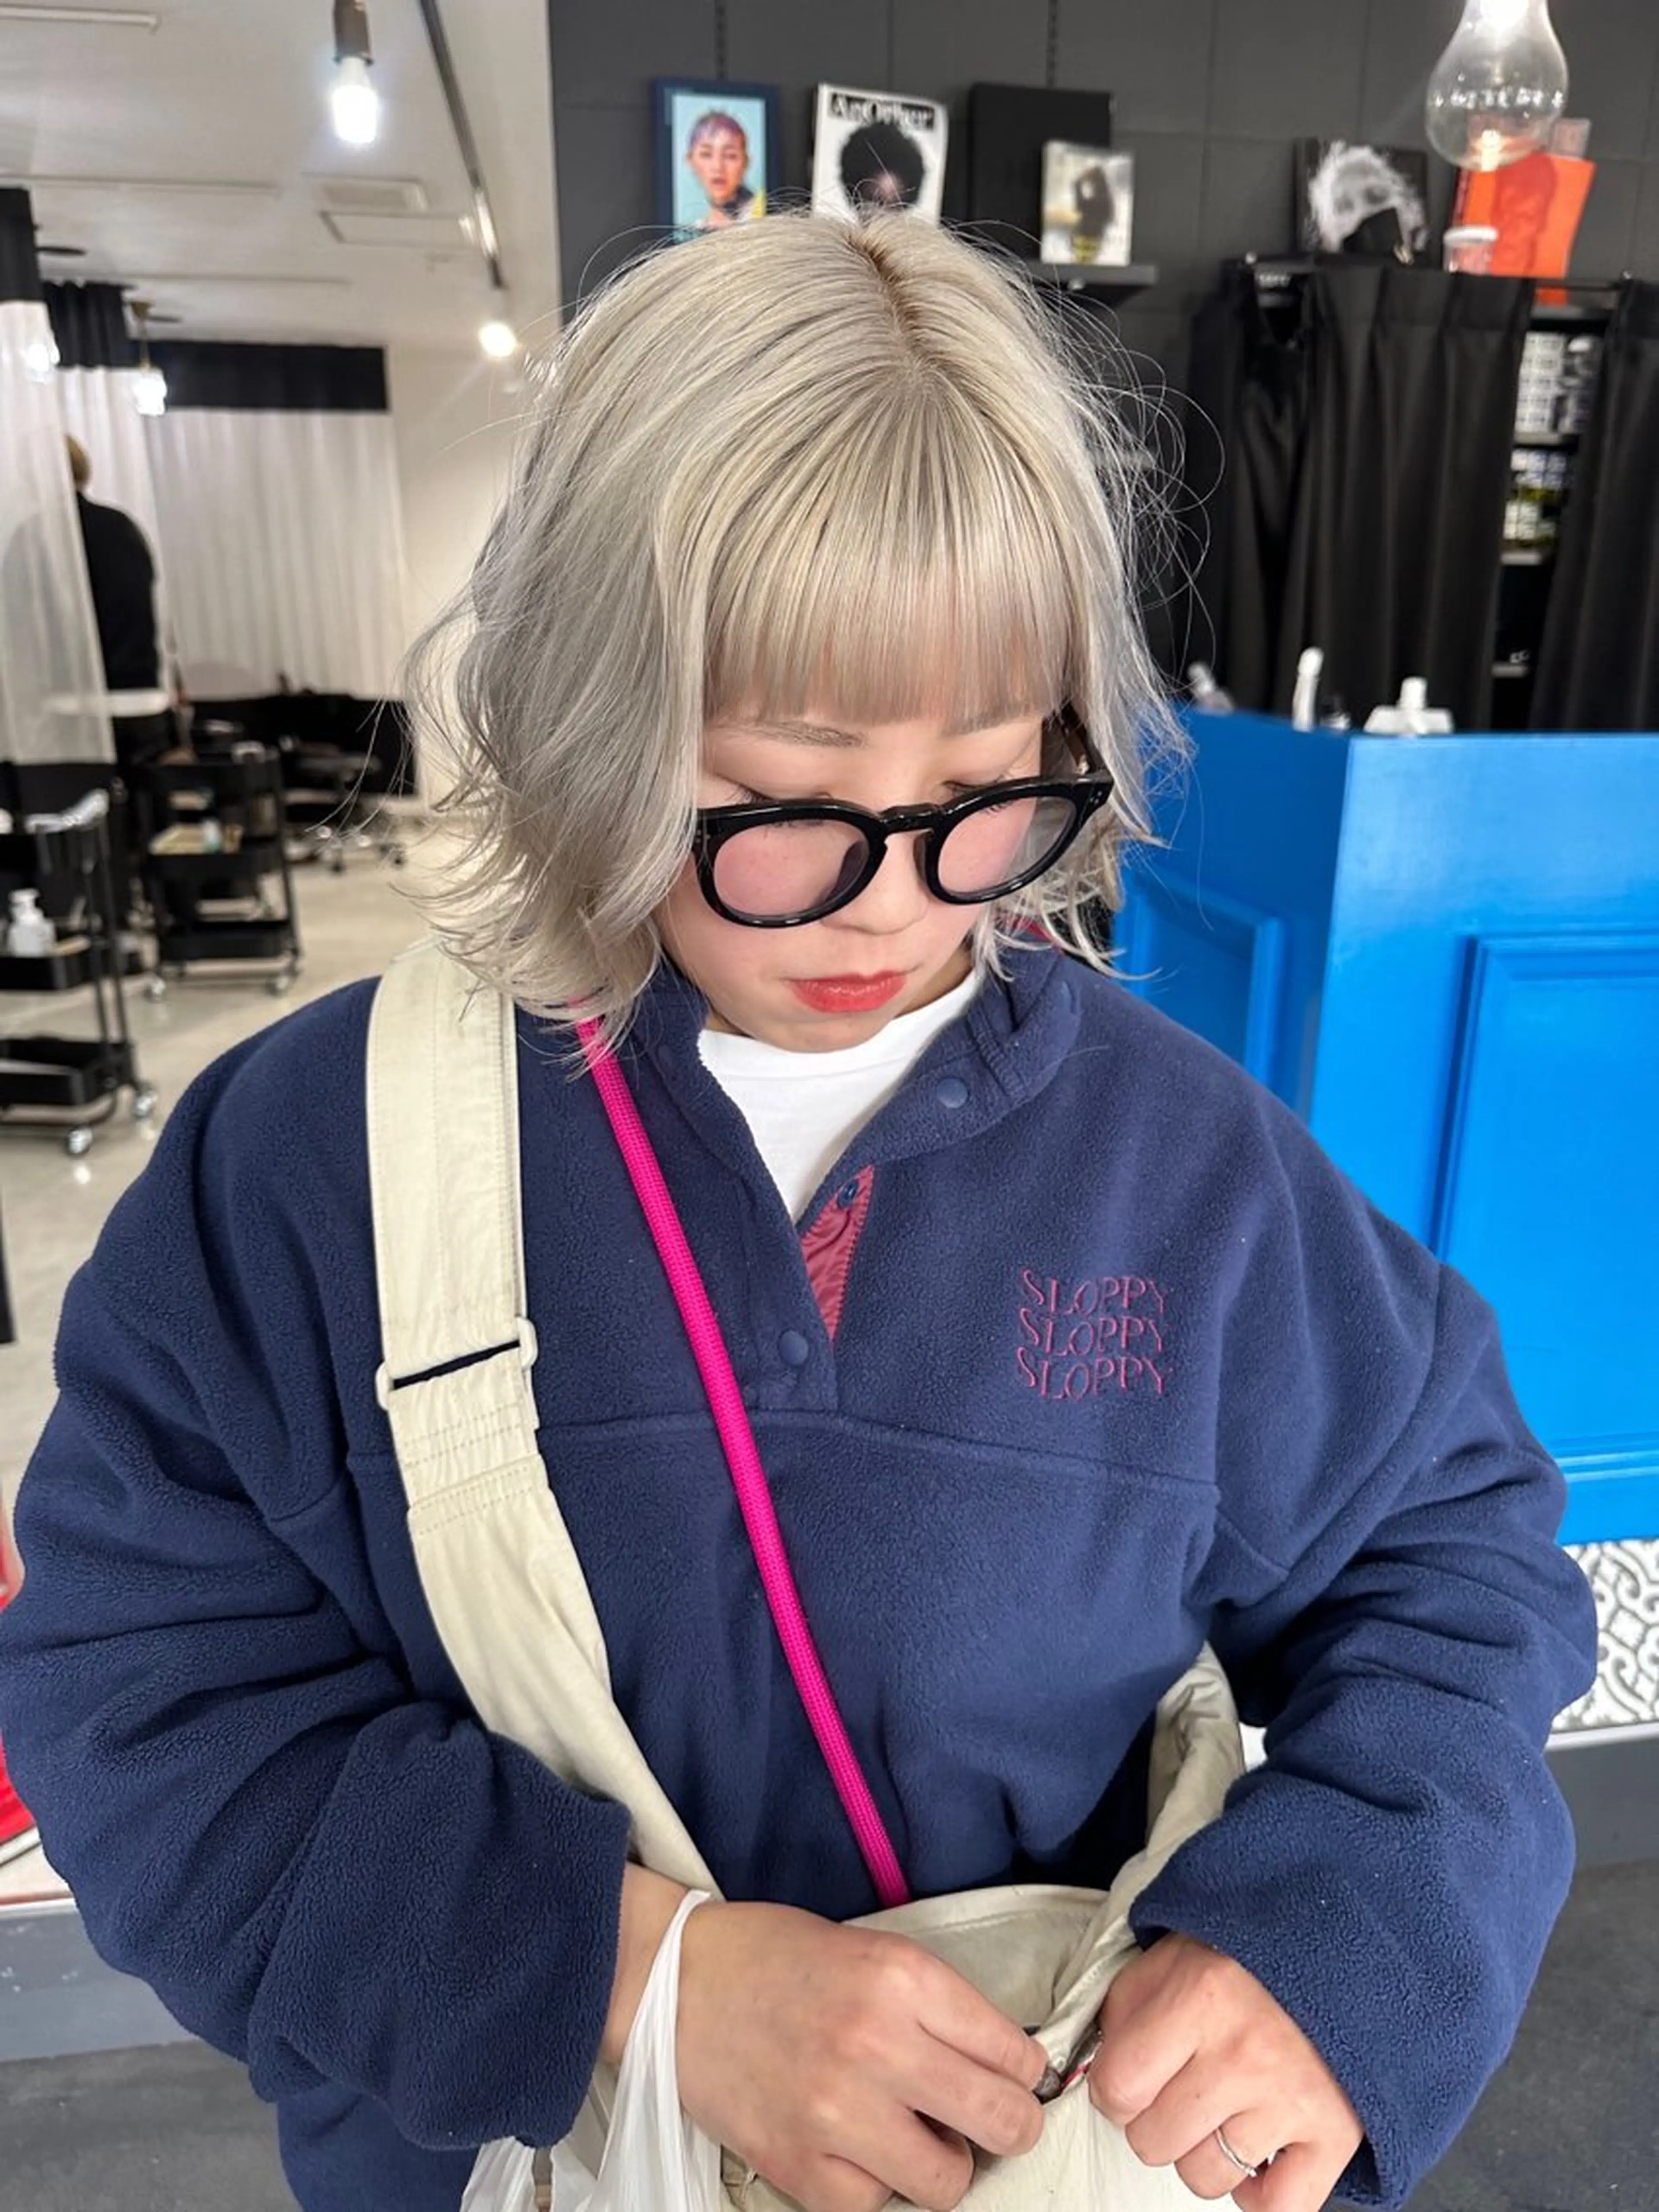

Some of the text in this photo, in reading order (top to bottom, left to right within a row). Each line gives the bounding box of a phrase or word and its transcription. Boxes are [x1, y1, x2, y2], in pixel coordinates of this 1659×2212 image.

[1023, 1269, 1165, 1315] SLOPPY
[1020, 1307, 1163, 1356] SLOPPY
[1017, 1347, 1163, 1401] SLOPPY
